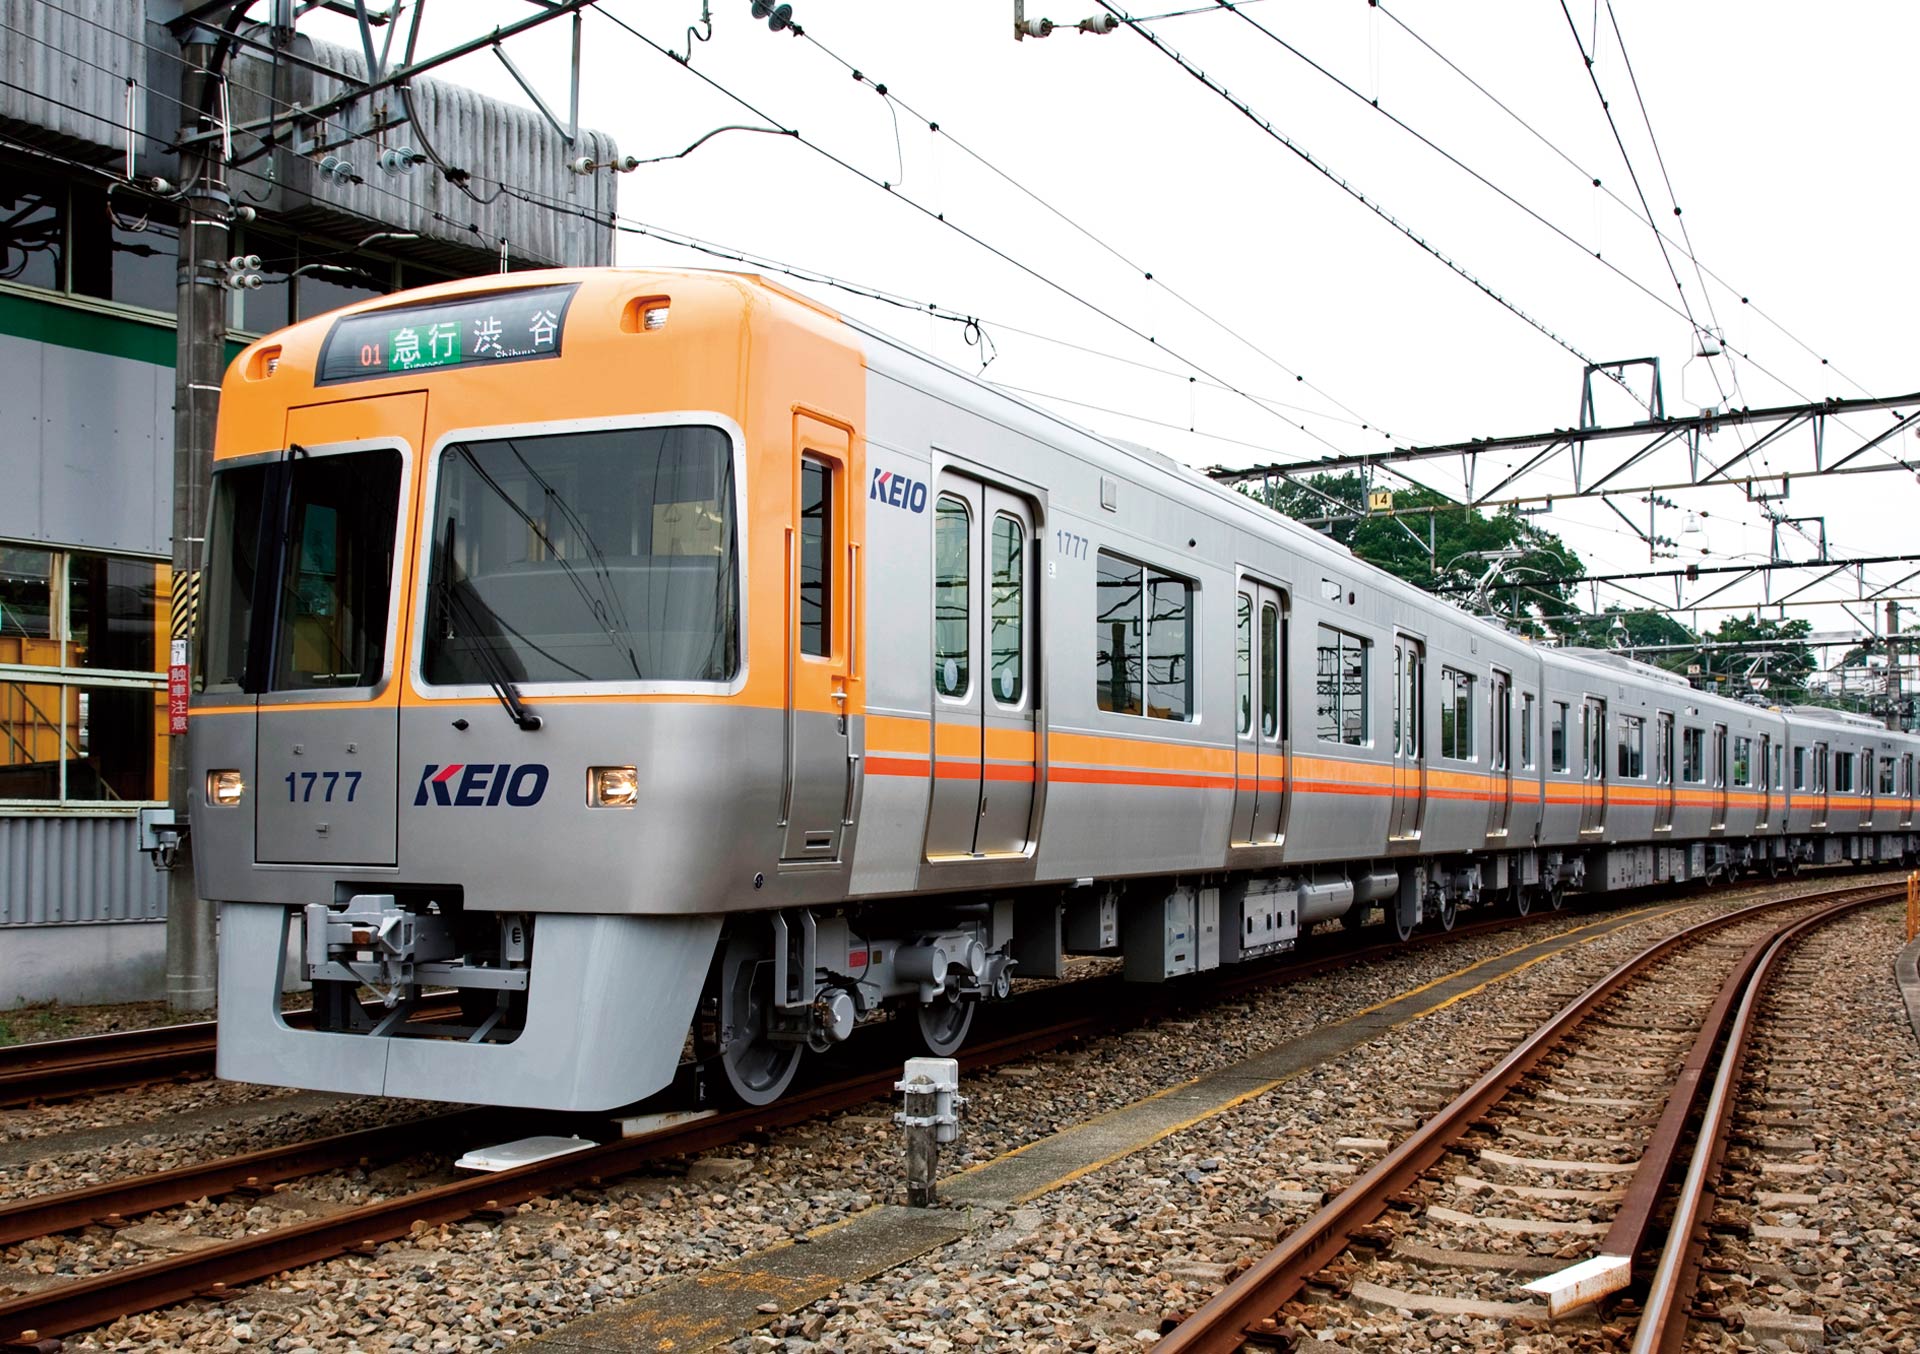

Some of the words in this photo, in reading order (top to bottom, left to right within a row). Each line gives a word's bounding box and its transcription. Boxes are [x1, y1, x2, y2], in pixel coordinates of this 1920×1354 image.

[360, 343, 382, 367] 01
[392, 322, 457, 364] 急行
[473, 310, 558, 354] 渋谷
[870, 467, 928, 514] KEIO
[1374, 494, 1388, 506] 14
[1057, 530, 1089, 560] 1777
[285, 771, 363, 803] 1777
[413, 764, 550, 807] KEIO
